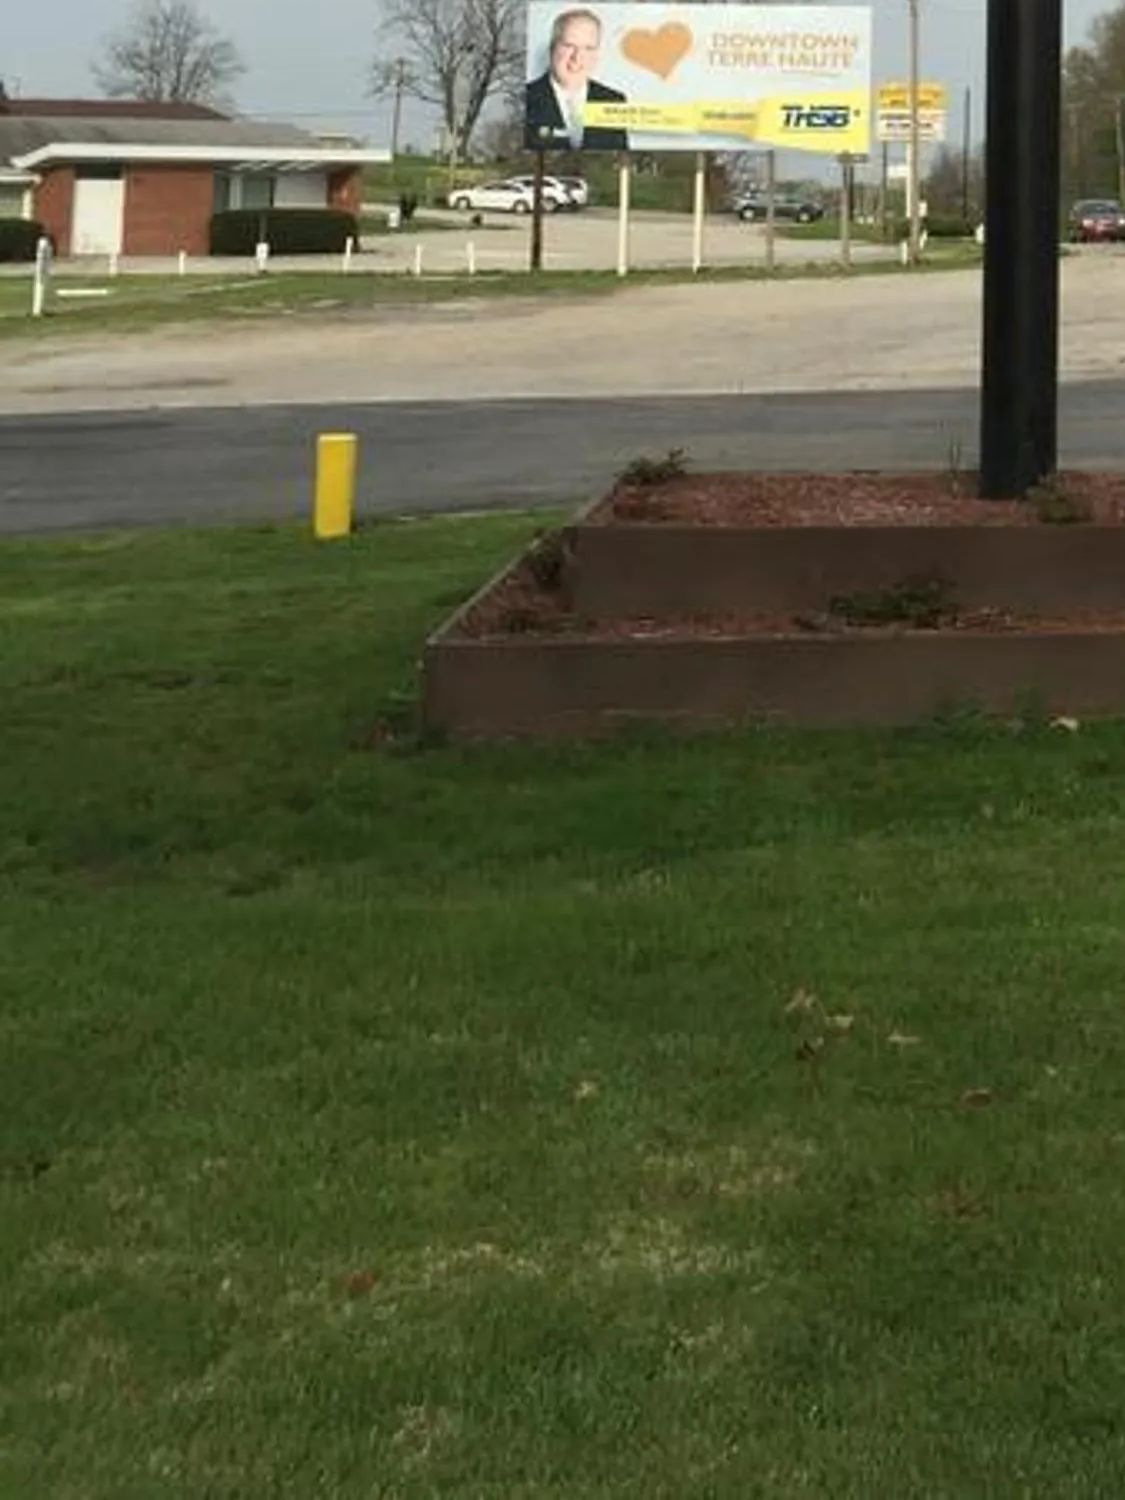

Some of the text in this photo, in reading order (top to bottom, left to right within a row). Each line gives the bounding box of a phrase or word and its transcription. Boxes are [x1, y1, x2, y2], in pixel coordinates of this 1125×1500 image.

[712, 31, 858, 50] DOWNTOWN
[707, 51, 853, 68] TERRE HAUTE
